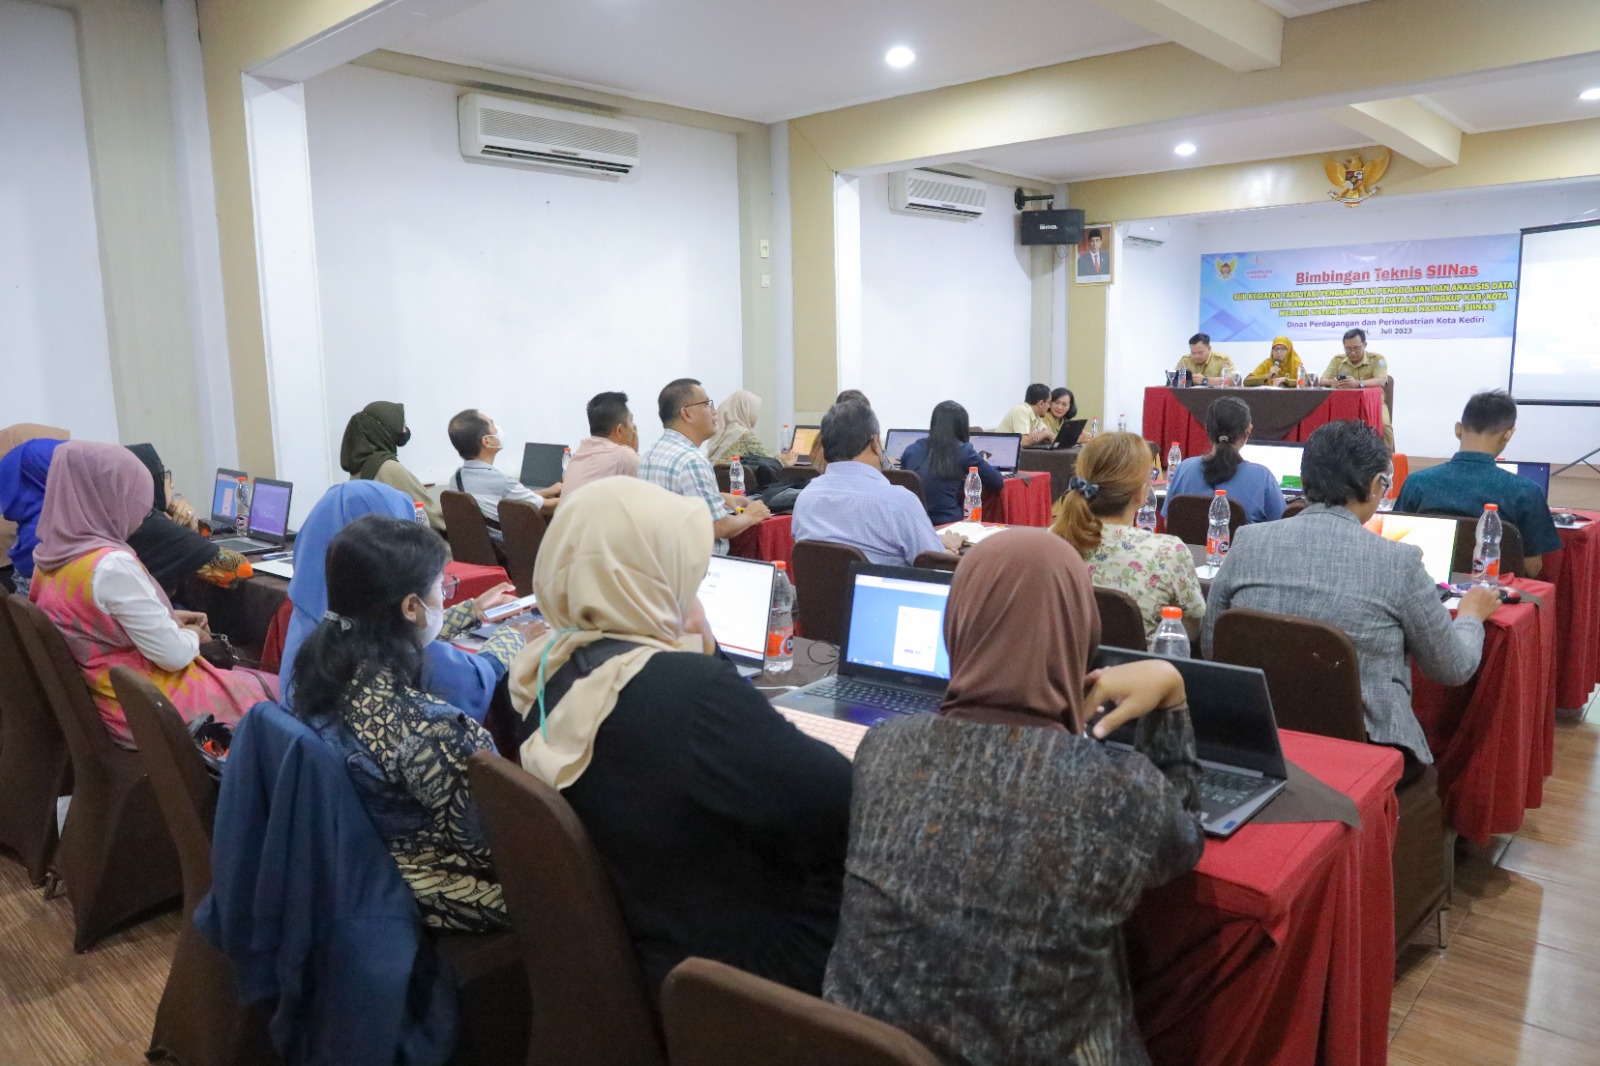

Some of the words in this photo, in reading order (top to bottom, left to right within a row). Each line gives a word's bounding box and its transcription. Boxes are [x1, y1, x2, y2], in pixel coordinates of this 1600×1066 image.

[1296, 269, 1371, 285] Bimbingan
[1374, 265, 1423, 281] Teknis
[1426, 263, 1479, 278] SIINas
[1233, 293, 1247, 301] SUB
[1248, 292, 1281, 300] KEGIATAN
[1282, 290, 1319, 299] FASILITASI
[1320, 287, 1377, 298] PENGUMPULAN
[1377, 285, 1431, 295] PENGOLAHAN
[1432, 284, 1450, 293] DAN
[1451, 282, 1490, 292] ANALISIS
[1491, 281, 1513, 290] DATA
[1288, 299, 1323, 308] KAWASAN
[1324, 297, 1359, 307] INDUSTRI
[1360, 296, 1384, 305] SERTA
[1385, 296, 1405, 304] DATA
[1406, 294, 1425, 304] LAIN
[1426, 293, 1463, 303] LINGKUP
[1279, 309, 1309, 317] MELALUI
[1310, 308, 1337, 316] SISTEM
[1338, 307, 1380, 315] INFORMASI
[1381, 305, 1418, 313] INDUSTRI
[1419, 304, 1461, 312] NASIONAL
[1462, 303, 1496, 312] (SIINAS)
[1310, 320, 1360, 329] Perdagangan
[1361, 319, 1377, 327] dan
[1379, 317, 1434, 326] Perindustrian
[1459, 315, 1485, 323] Kediri
[1394, 327, 1413, 335] 2023
